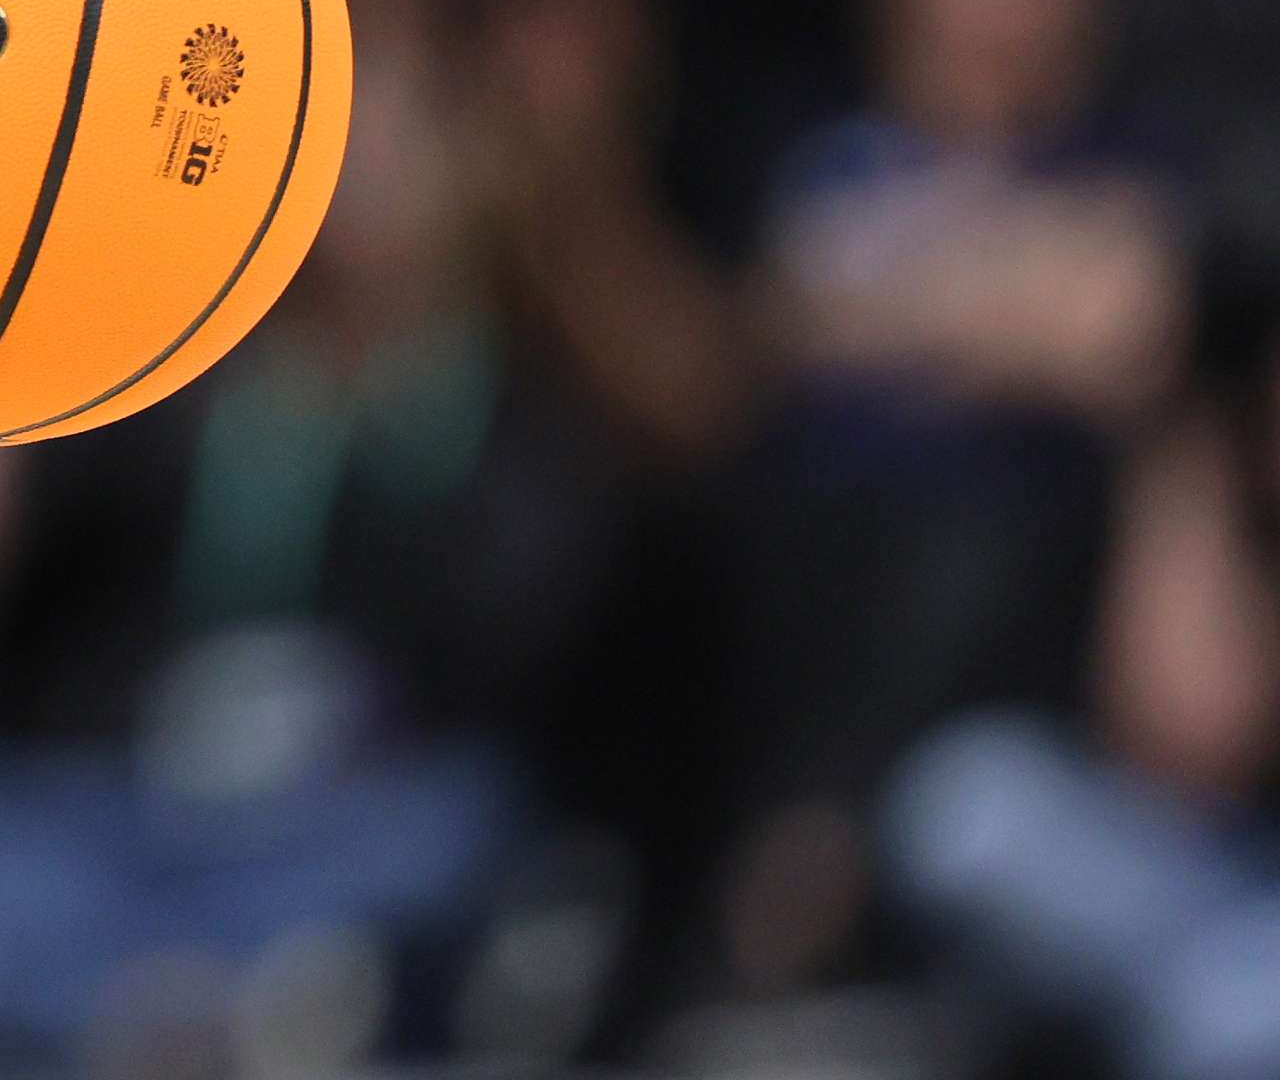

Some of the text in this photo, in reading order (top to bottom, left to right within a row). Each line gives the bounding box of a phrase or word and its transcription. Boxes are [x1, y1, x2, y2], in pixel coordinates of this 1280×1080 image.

[158, 76, 171, 103] GAME
[151, 105, 165, 127] BALL
[162, 110, 188, 179] TOURNAMENT
